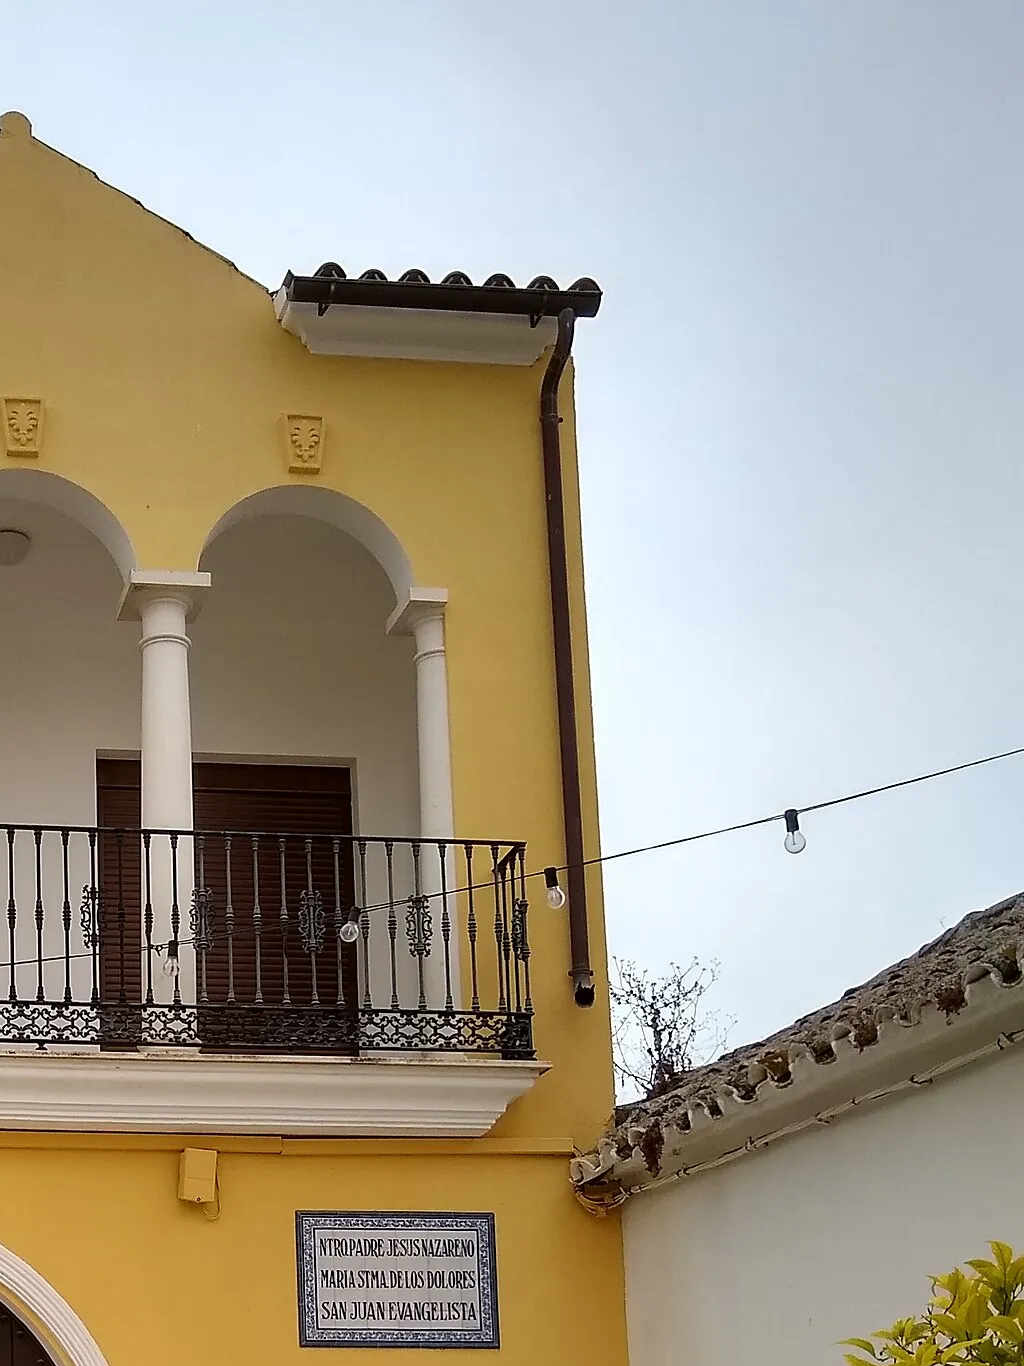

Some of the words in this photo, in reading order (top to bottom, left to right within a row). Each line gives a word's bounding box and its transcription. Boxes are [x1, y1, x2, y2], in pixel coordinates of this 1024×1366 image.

[349, 1238, 385, 1258] PADRE
[386, 1239, 420, 1258] JESUS
[421, 1239, 475, 1258] NAZARENO
[320, 1269, 356, 1289] MARIA
[389, 1271, 404, 1288] DE
[405, 1271, 425, 1289] LOS
[428, 1270, 476, 1290] DOLORES
[321, 1301, 347, 1320] SAN
[349, 1301, 385, 1320] JUAN
[388, 1301, 477, 1321] EVANGELISTA
